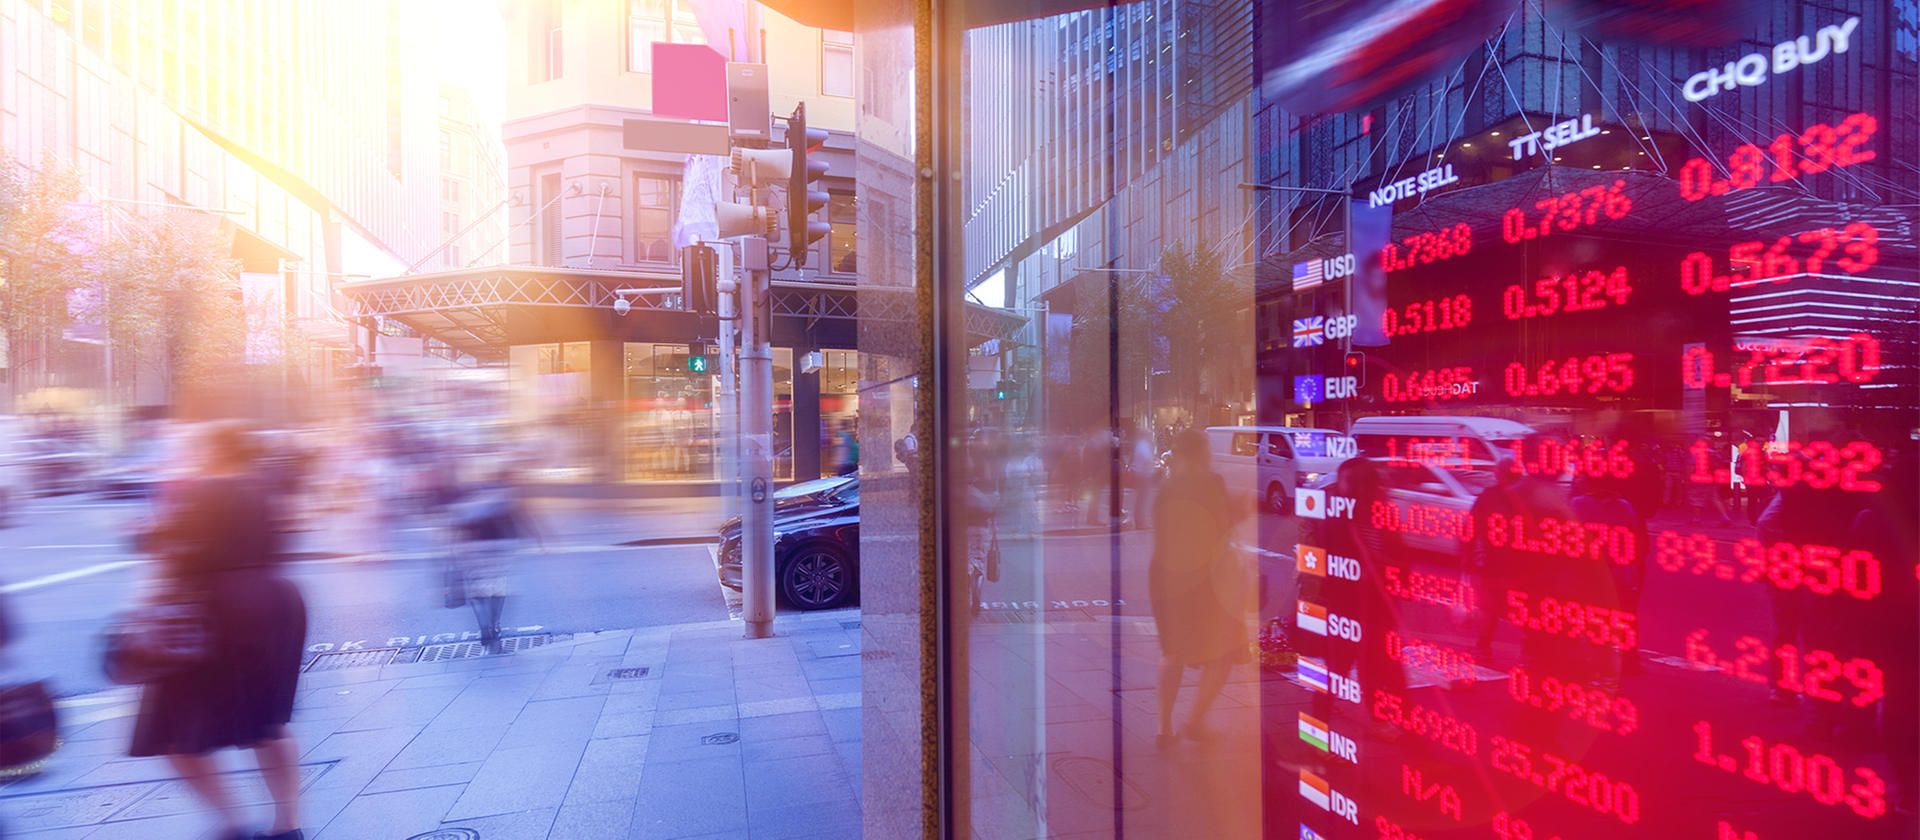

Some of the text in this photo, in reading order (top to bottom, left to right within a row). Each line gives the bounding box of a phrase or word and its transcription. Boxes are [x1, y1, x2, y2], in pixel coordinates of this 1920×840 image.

[1682, 16, 1859, 102] CHQ BUY
[1508, 113, 1600, 160] TT SELL
[1324, 112, 1878, 281] USD 0.7368 0.7376 0.8132
[1369, 163, 1459, 208] NOTE SELL
[1325, 222, 1879, 340] GBP 0.5118 0.5124 0.5673
[1325, 376, 1358, 400] EUR
[1504, 352, 1634, 397] 0.6495
[1326, 436, 1358, 458] NZD
[1510, 438, 1635, 478] 1.0666
[1689, 440, 1882, 492] 1.1532
[1327, 496, 1882, 600] JPY 80.0530 81.3370 89.9850
[1327, 554, 1361, 581] HKD
[1507, 589, 1637, 651] 5.8955
[1686, 628, 1884, 707] 6.2129
[1328, 613, 1362, 643] SGD
[1507, 666, 1638, 736] 0.9929
[1693, 720, 1886, 819] 1.1003
[1329, 672, 1640, 825] THB 25.6920 25.7200
[1329, 730, 1358, 764] INR
[1402, 763, 1461, 821] N/A
[1330, 789, 1359, 826] IDR
